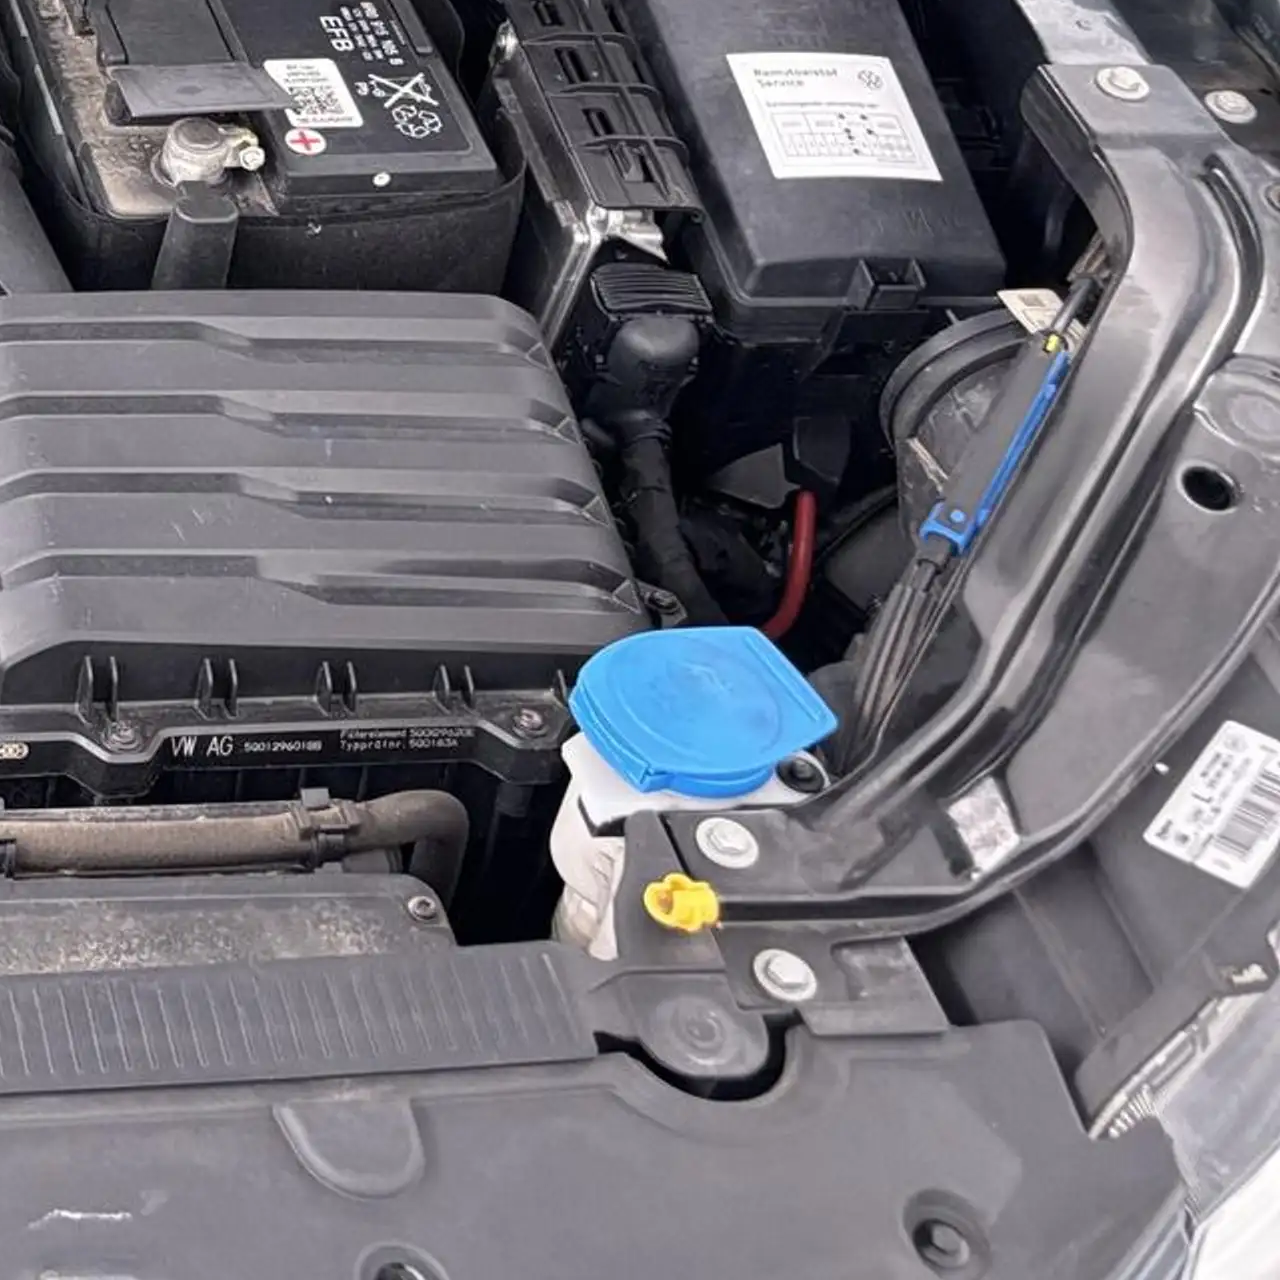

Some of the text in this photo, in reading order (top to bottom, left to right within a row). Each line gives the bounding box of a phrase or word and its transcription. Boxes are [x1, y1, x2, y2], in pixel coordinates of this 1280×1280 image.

[320, 15, 355, 51] EFB
[170, 735, 197, 757] VW
[206, 735, 233, 757] AG
